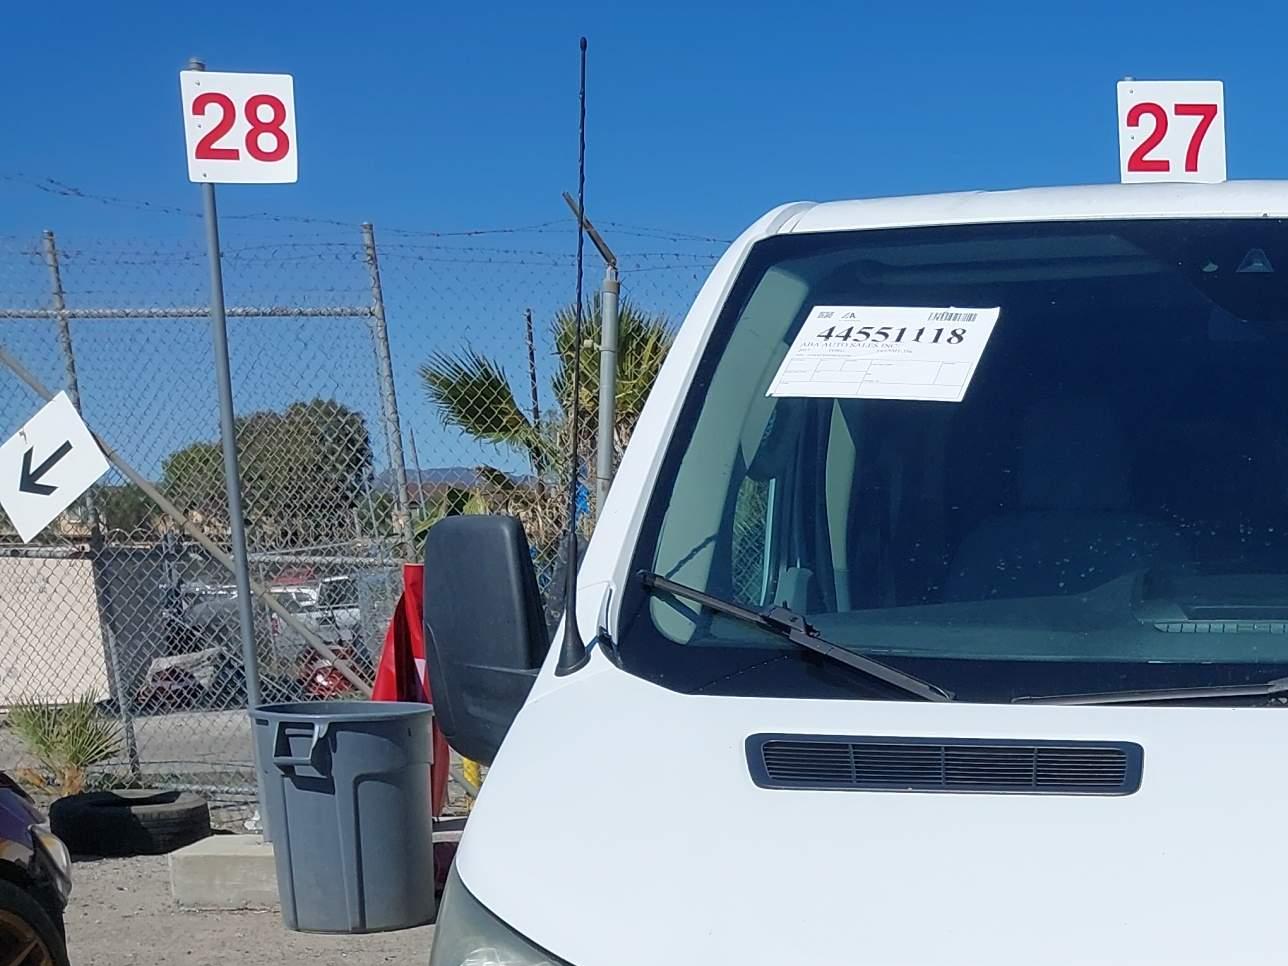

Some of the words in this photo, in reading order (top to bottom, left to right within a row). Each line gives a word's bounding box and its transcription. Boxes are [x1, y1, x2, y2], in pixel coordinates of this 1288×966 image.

[191, 91, 290, 162] 28
[1126, 101, 1218, 173] 27
[816, 325, 968, 345] 44551118
